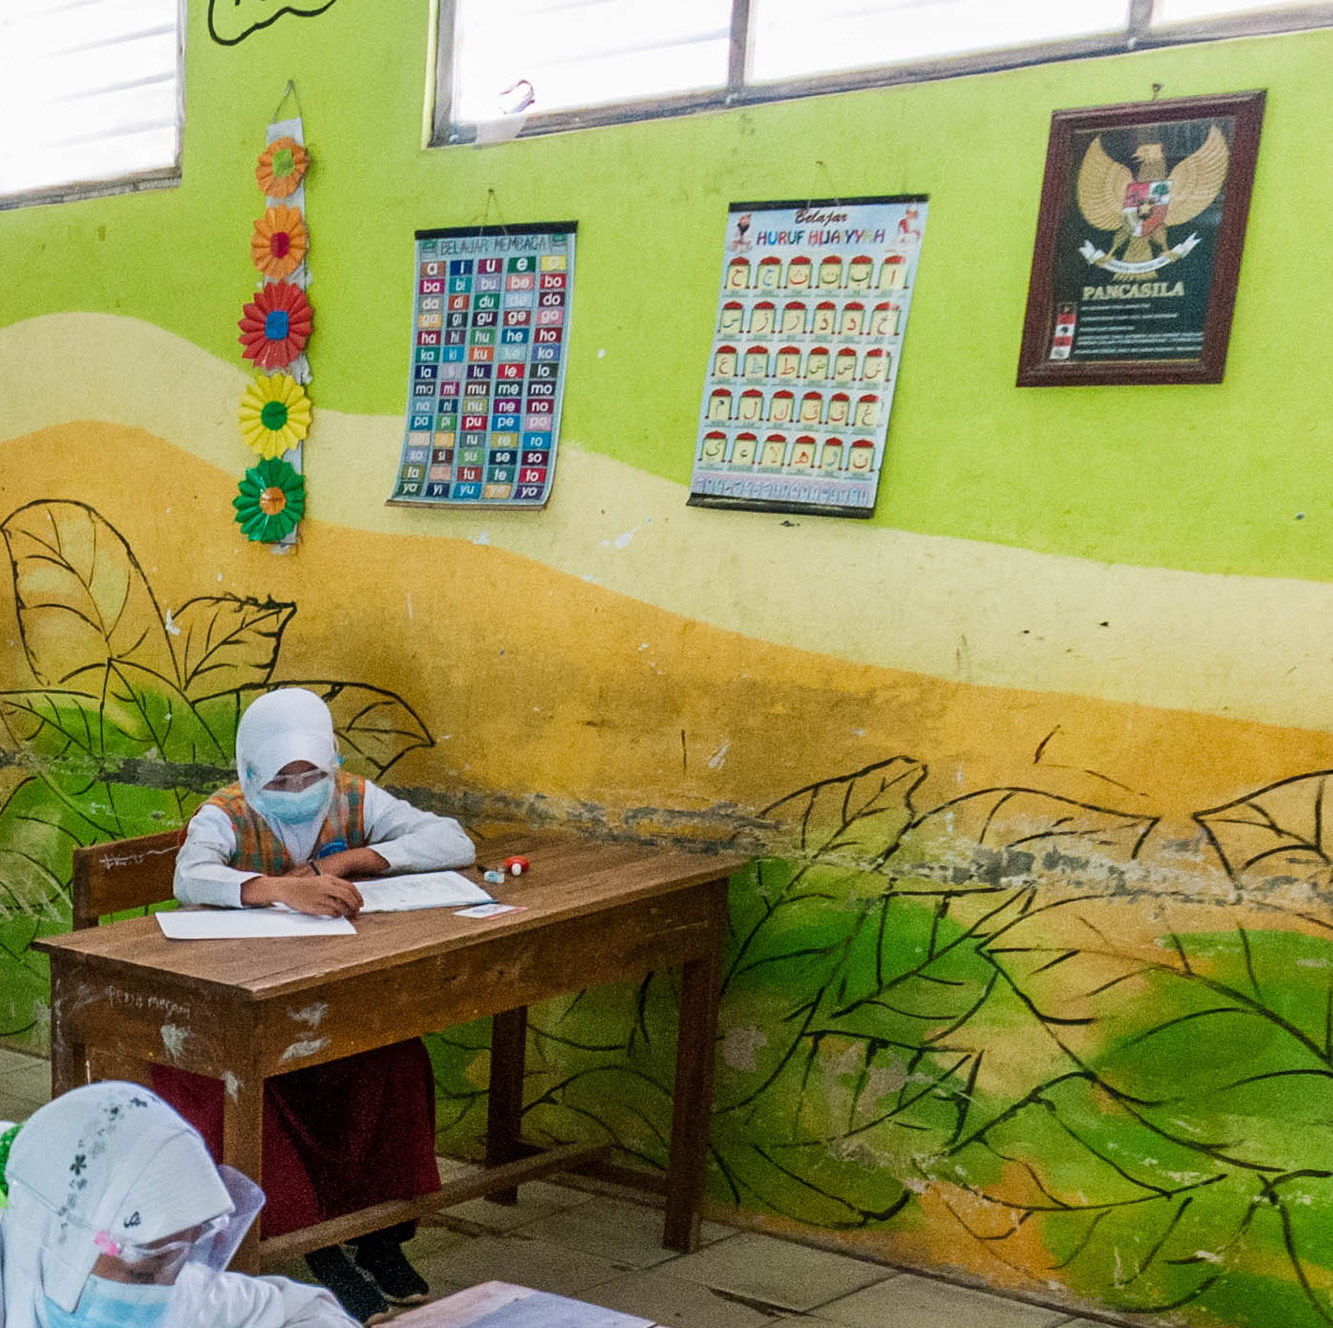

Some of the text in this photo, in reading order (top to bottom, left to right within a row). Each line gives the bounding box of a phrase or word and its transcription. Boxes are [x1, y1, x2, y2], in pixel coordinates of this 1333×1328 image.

[795, 209, 847, 227] Belajar
[757, 231, 804, 245] HURUF
[427, 263, 437, 275] a
[487, 260, 495, 272] u
[517, 259, 527, 270] e
[424, 275, 562, 292] ba bi bu be bo
[1084, 281, 1185, 300] PANCASILA
[423, 297, 439, 309] da
[454, 296, 463, 307] di
[479, 295, 494, 307] du
[543, 293, 560, 305] do
[452, 314, 462, 325] gi
[477, 313, 492, 325] gu
[508, 312, 526, 324] ge
[541, 311, 558, 323] go
[422, 328, 556, 344] ha hi hu he ho
[421, 348, 434, 360] ka
[449, 348, 456, 359] ki
[474, 347, 487, 359] ku
[537, 345, 553, 359] ko
[421, 365, 431, 377] la
[474, 364, 483, 377] lu
[538, 364, 550, 377] lo
[416, 382, 552, 394] ma mi mu me mo
[444, 400, 452, 411] ni
[468, 401, 482, 412] nu
[532, 401, 548, 411] no
[414, 416, 428, 426] pa
[442, 416, 450, 427] pi
[466, 417, 482, 427] pu
[467, 434, 477, 444] ru
[531, 436, 542, 446] ro
[438, 450, 446, 460] si
[464, 450, 477, 461] su
[496, 451, 510, 462] se
[528, 453, 541, 463] so
[408, 467, 539, 481] ta tu te to
[403, 484, 417, 493] ya
[434, 484, 442, 494] yi
[460, 484, 474, 495] yu
[522, 487, 537, 497] yo
